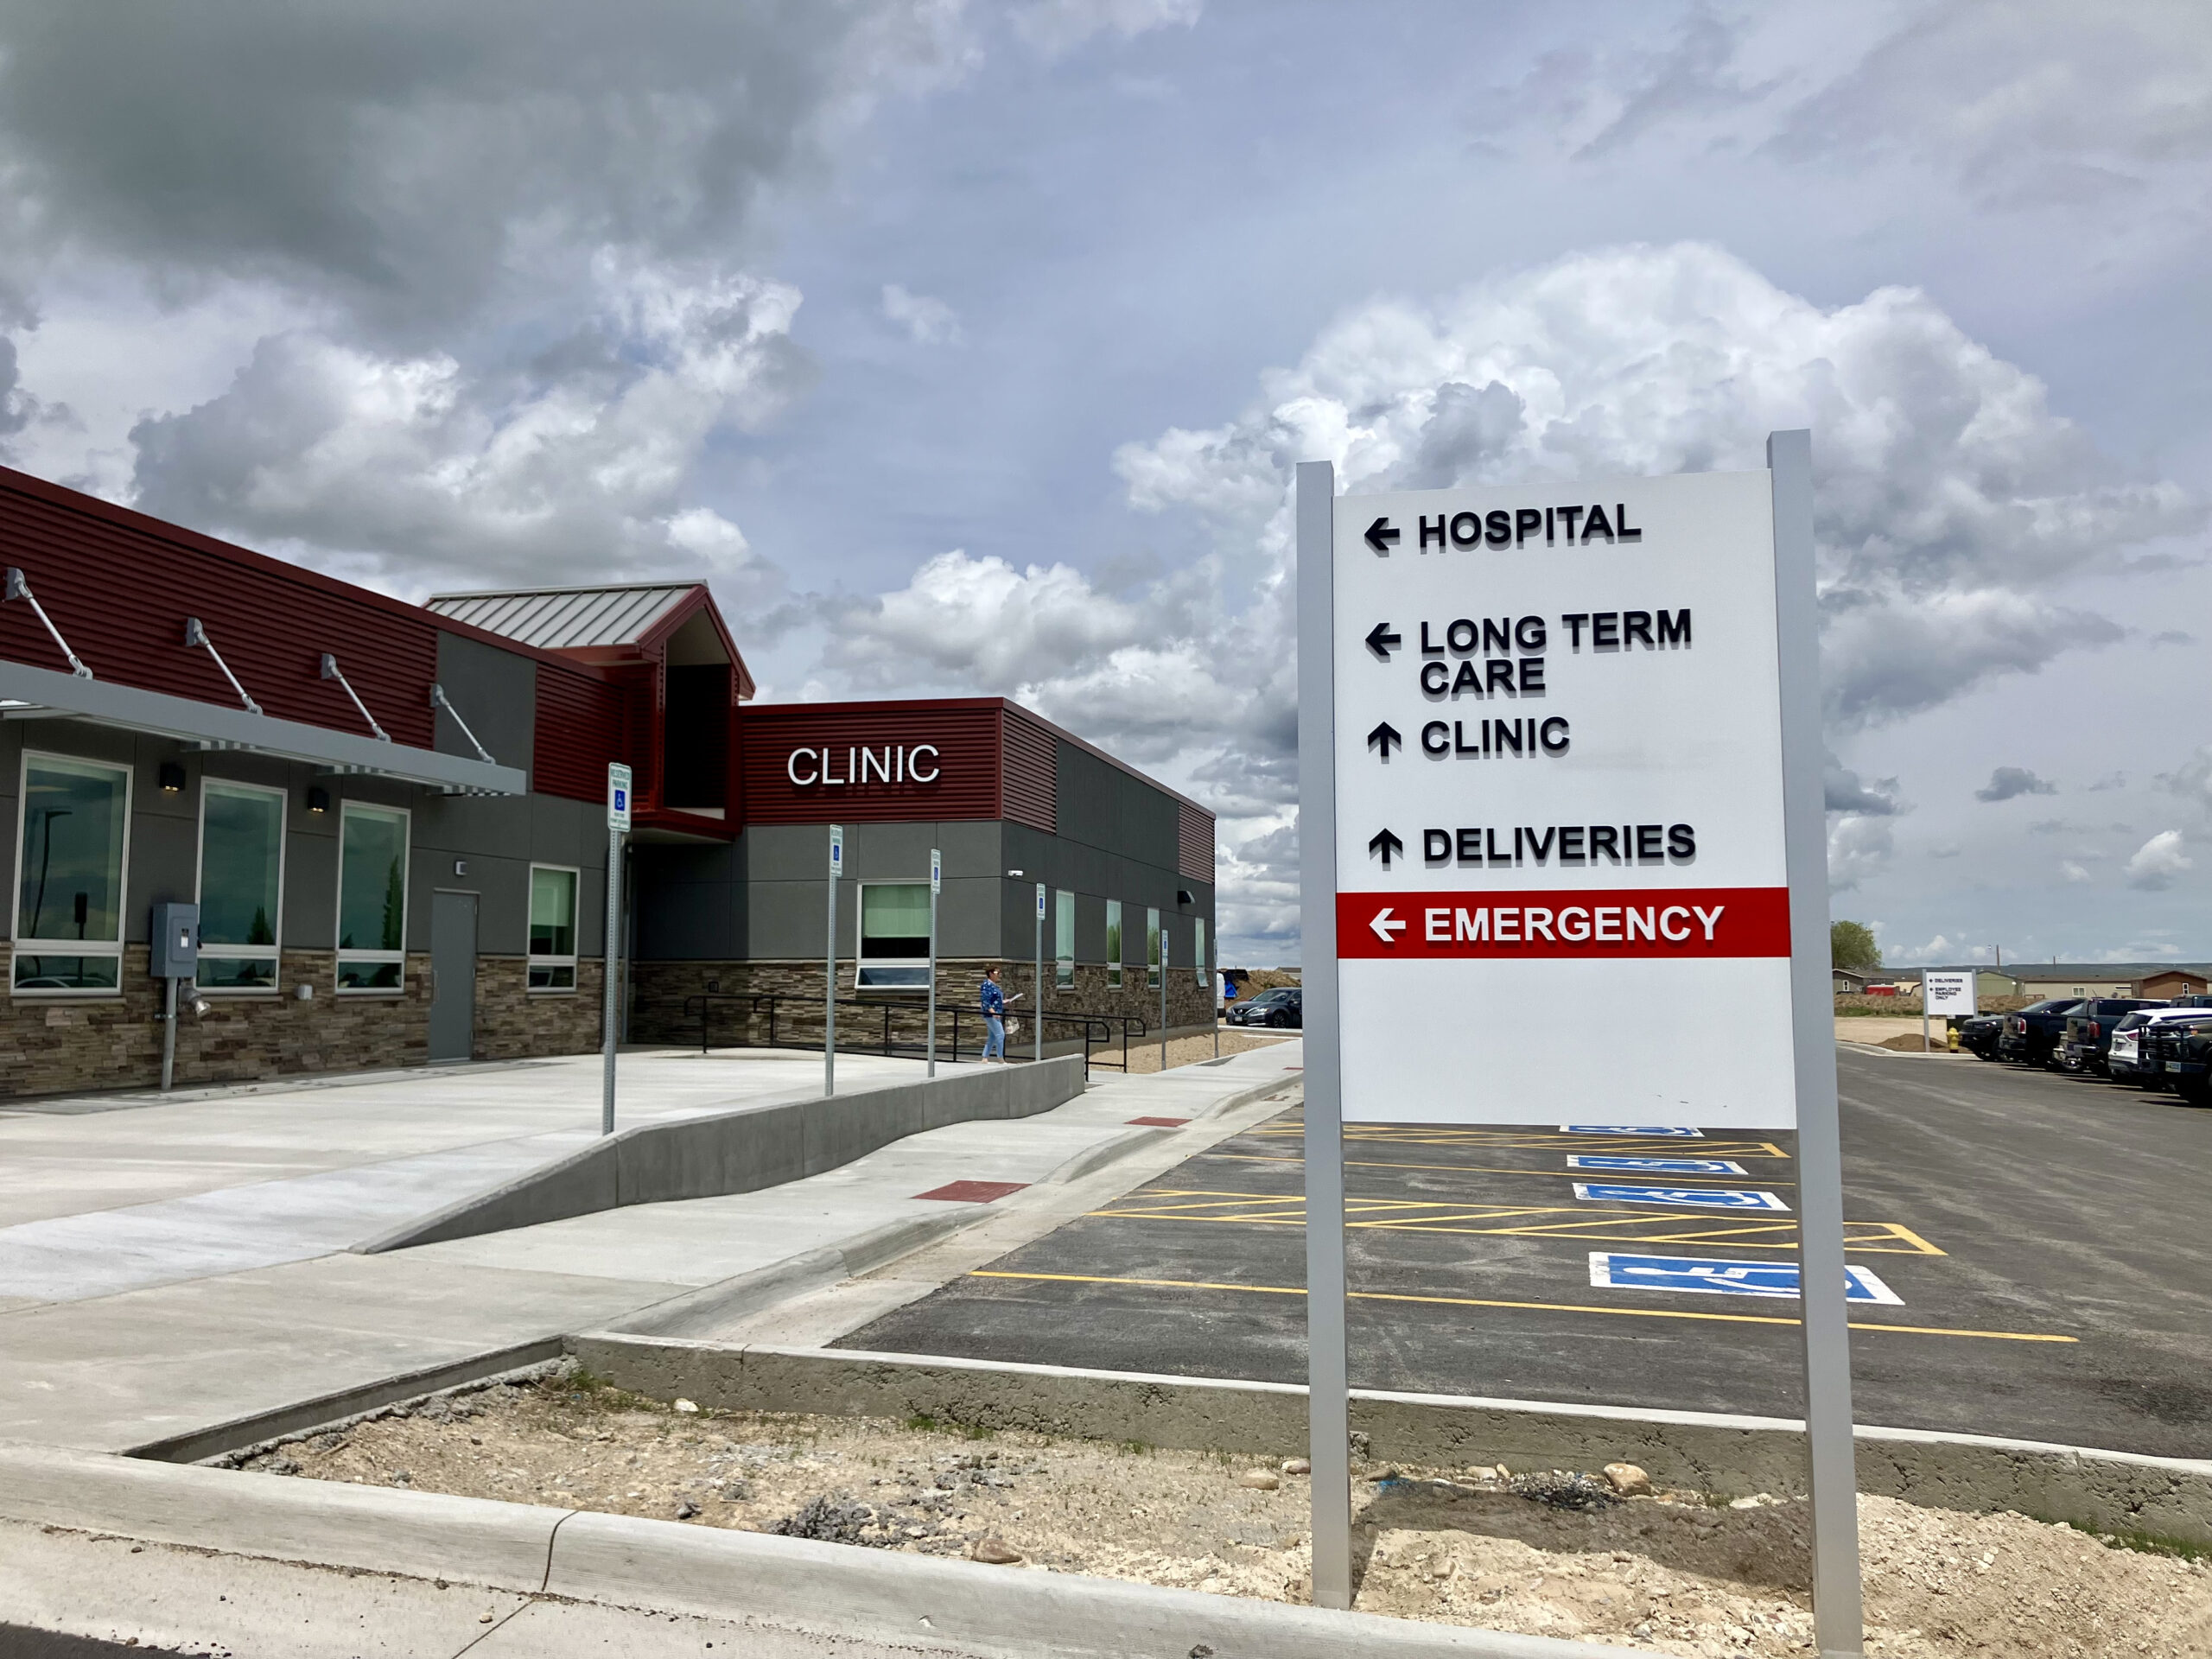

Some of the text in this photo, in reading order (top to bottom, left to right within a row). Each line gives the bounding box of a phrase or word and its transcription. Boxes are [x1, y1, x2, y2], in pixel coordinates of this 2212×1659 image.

[1419, 503, 1642, 549] HOSPITAL
[1421, 608, 1692, 655] LONG TERM
[1420, 657, 1546, 696] CARE
[1421, 716, 1570, 756] CLINIC
[787, 744, 940, 785] CLINIC
[1423, 823, 1696, 862] DELIVERIES
[1425, 906, 1726, 944] EMERGENCY
